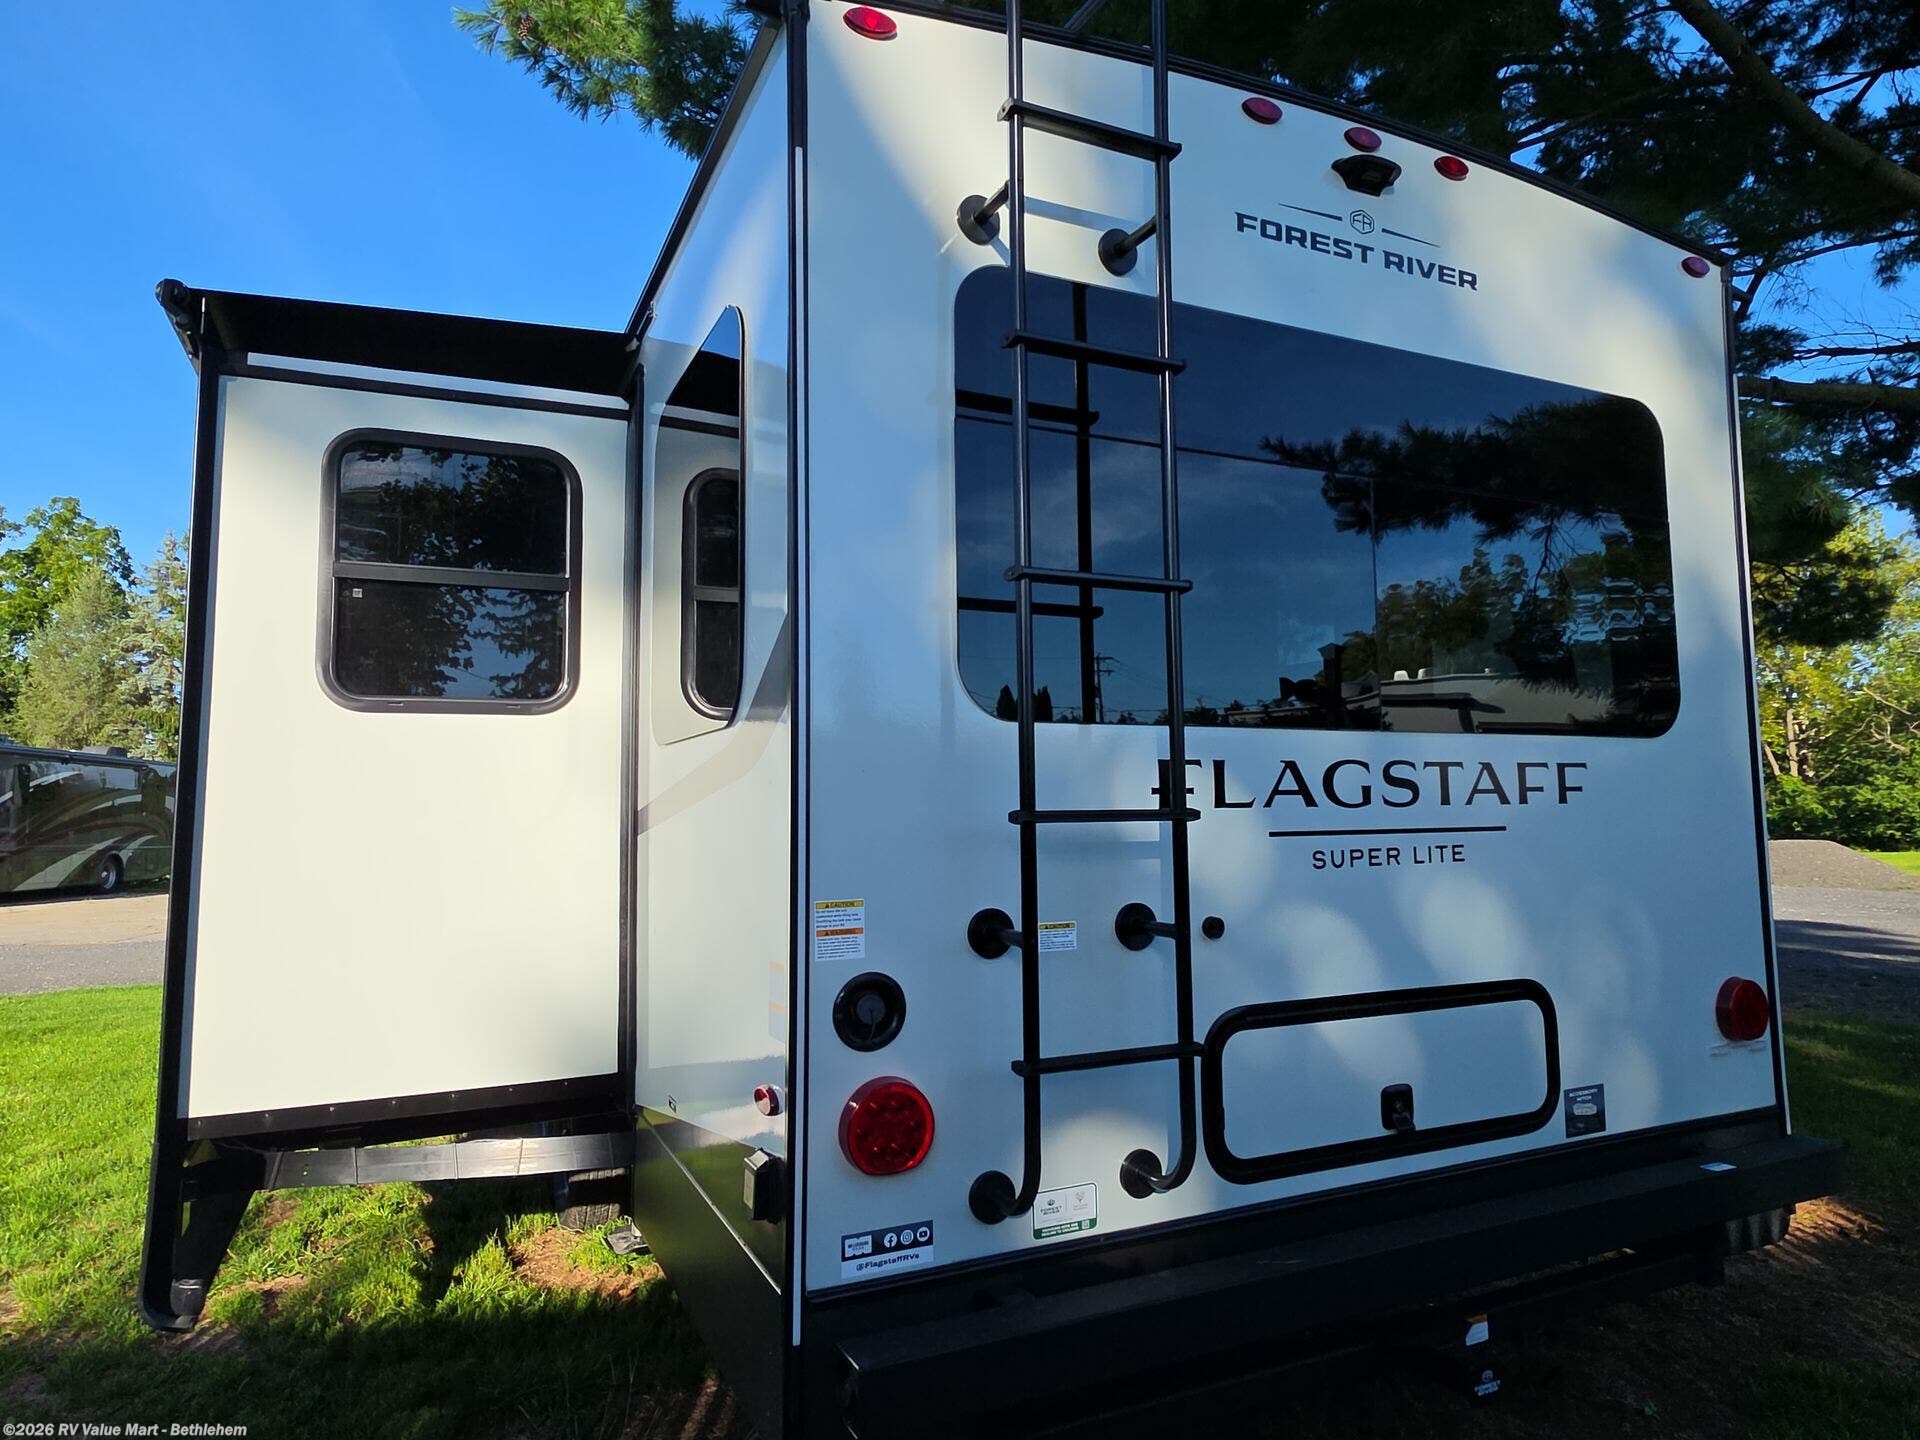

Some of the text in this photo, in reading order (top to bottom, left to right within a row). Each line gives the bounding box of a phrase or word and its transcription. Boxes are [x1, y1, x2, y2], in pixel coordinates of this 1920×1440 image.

[1235, 212, 1477, 291] FOREST RIVER
[1151, 758, 1588, 809] FLAGSTAFF
[1312, 844, 1465, 870] SUPER LITE
[856, 1253, 919, 1271] @FlagstaffRVs
